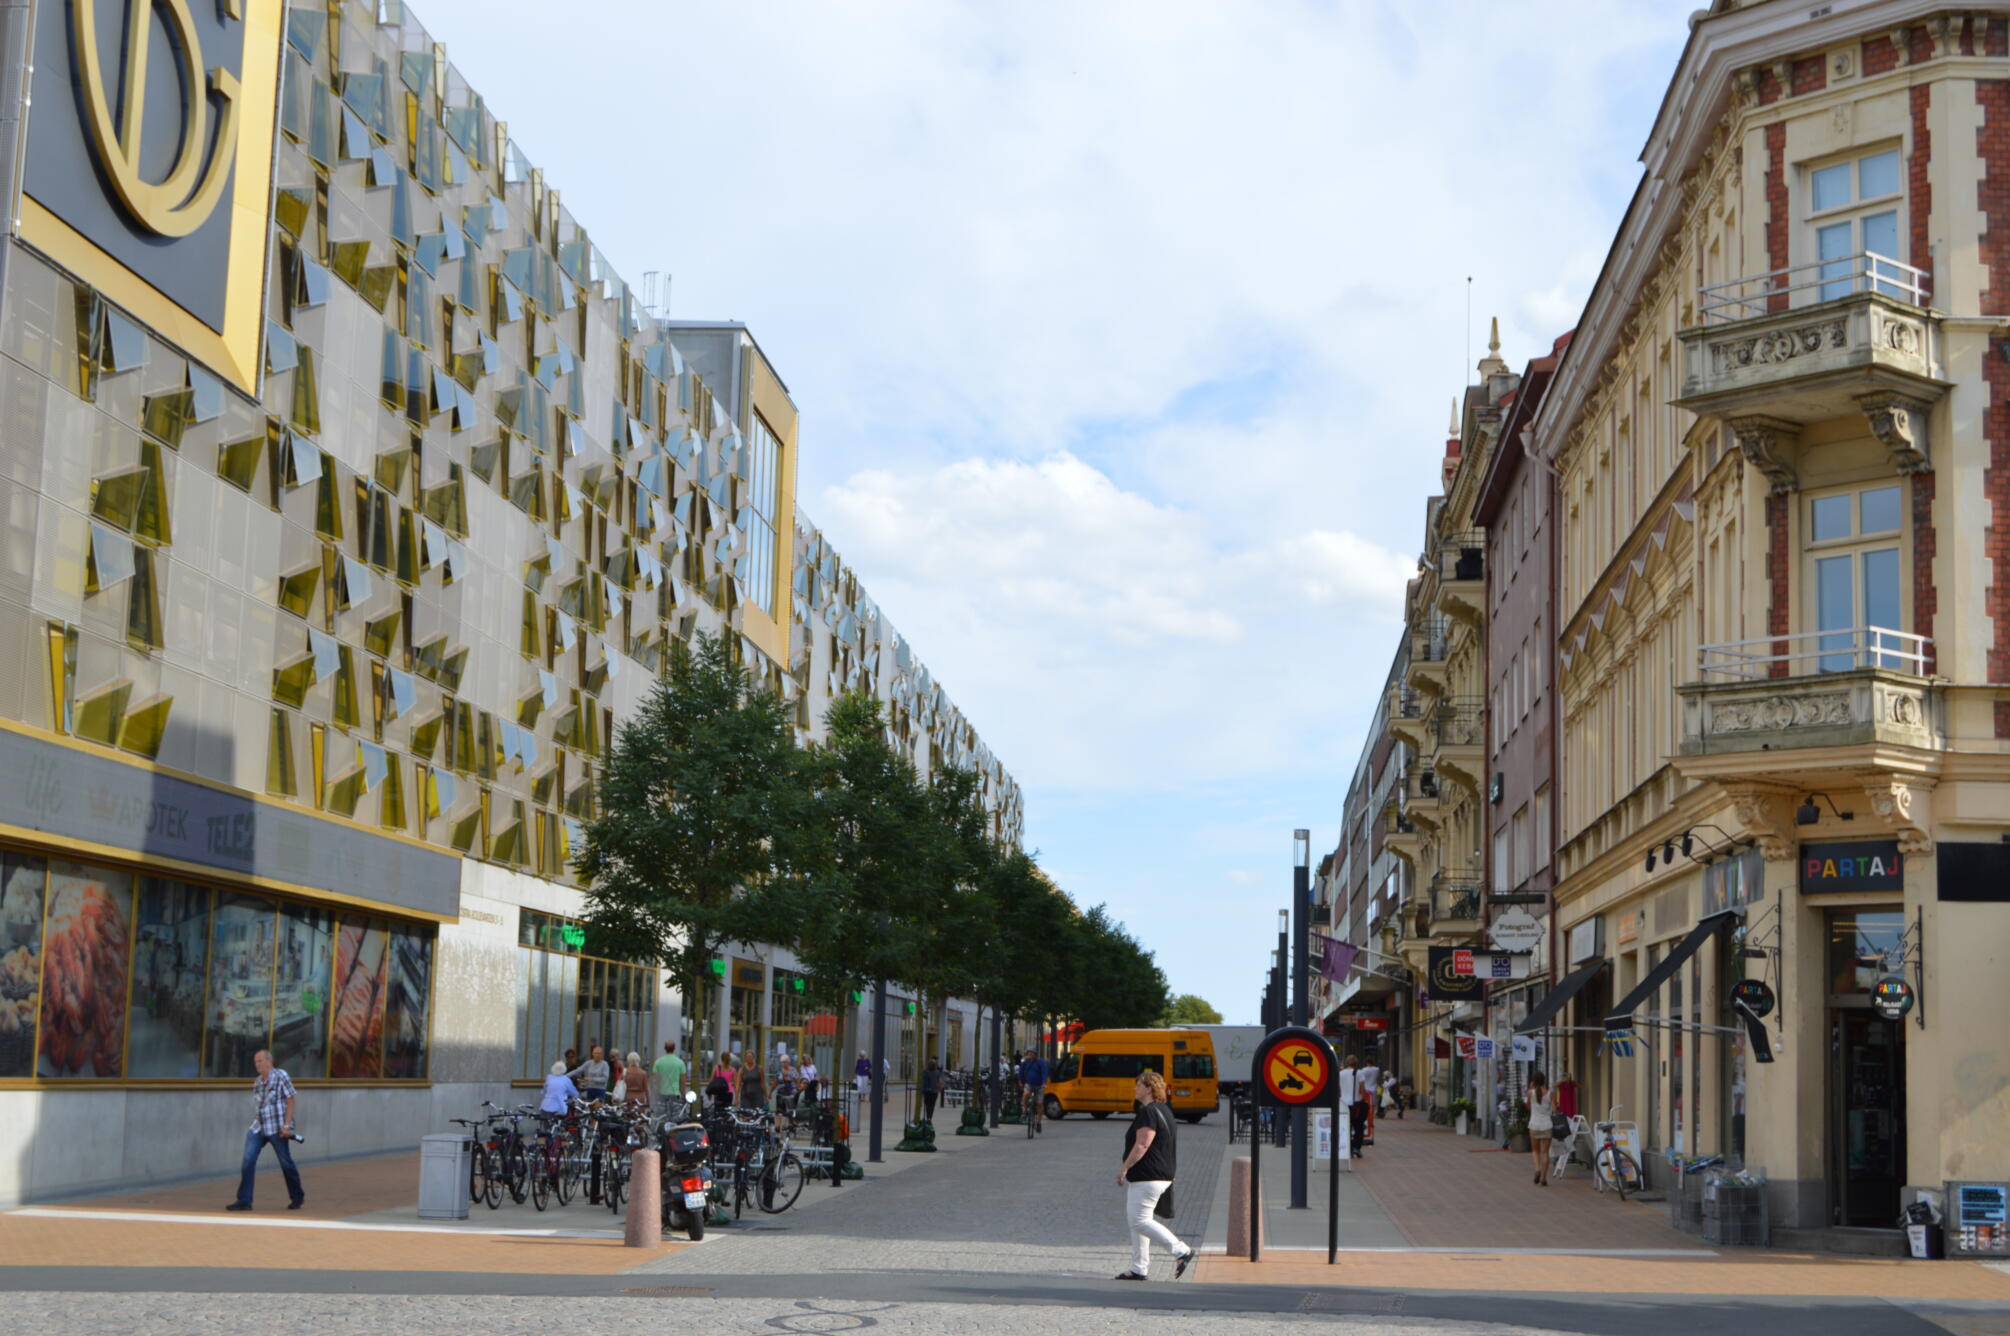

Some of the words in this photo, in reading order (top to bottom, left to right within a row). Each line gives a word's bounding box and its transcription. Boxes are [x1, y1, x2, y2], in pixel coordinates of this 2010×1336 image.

[118, 797, 189, 841] APOTEK
[1807, 856, 1900, 878] PARTAJ
[1878, 983, 1907, 994] PARTAJ
